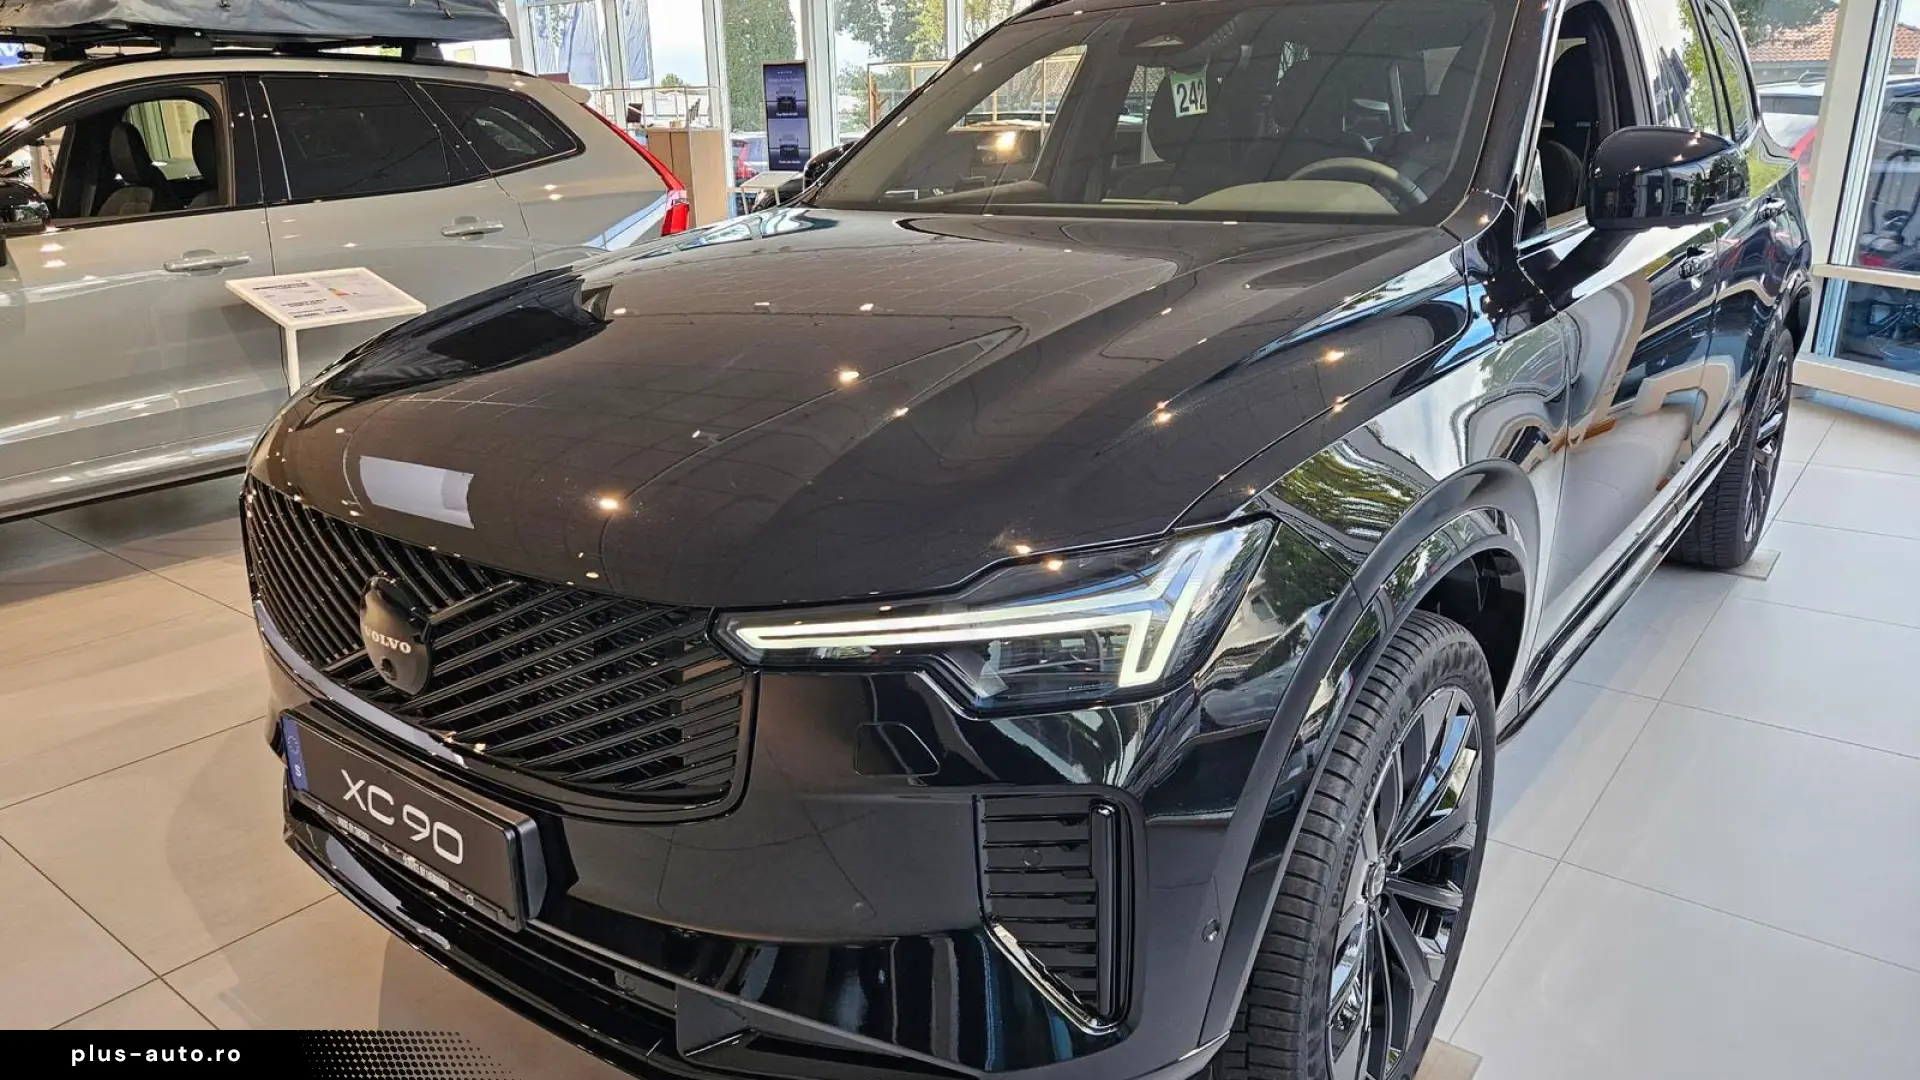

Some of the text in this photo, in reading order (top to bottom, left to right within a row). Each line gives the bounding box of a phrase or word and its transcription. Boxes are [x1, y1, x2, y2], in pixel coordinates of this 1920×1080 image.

[1176, 79, 1206, 113] 242
[364, 625, 411, 654] VOLVO
[294, 764, 302, 777] S
[341, 769, 395, 826] XC
[402, 804, 463, 865] 90
